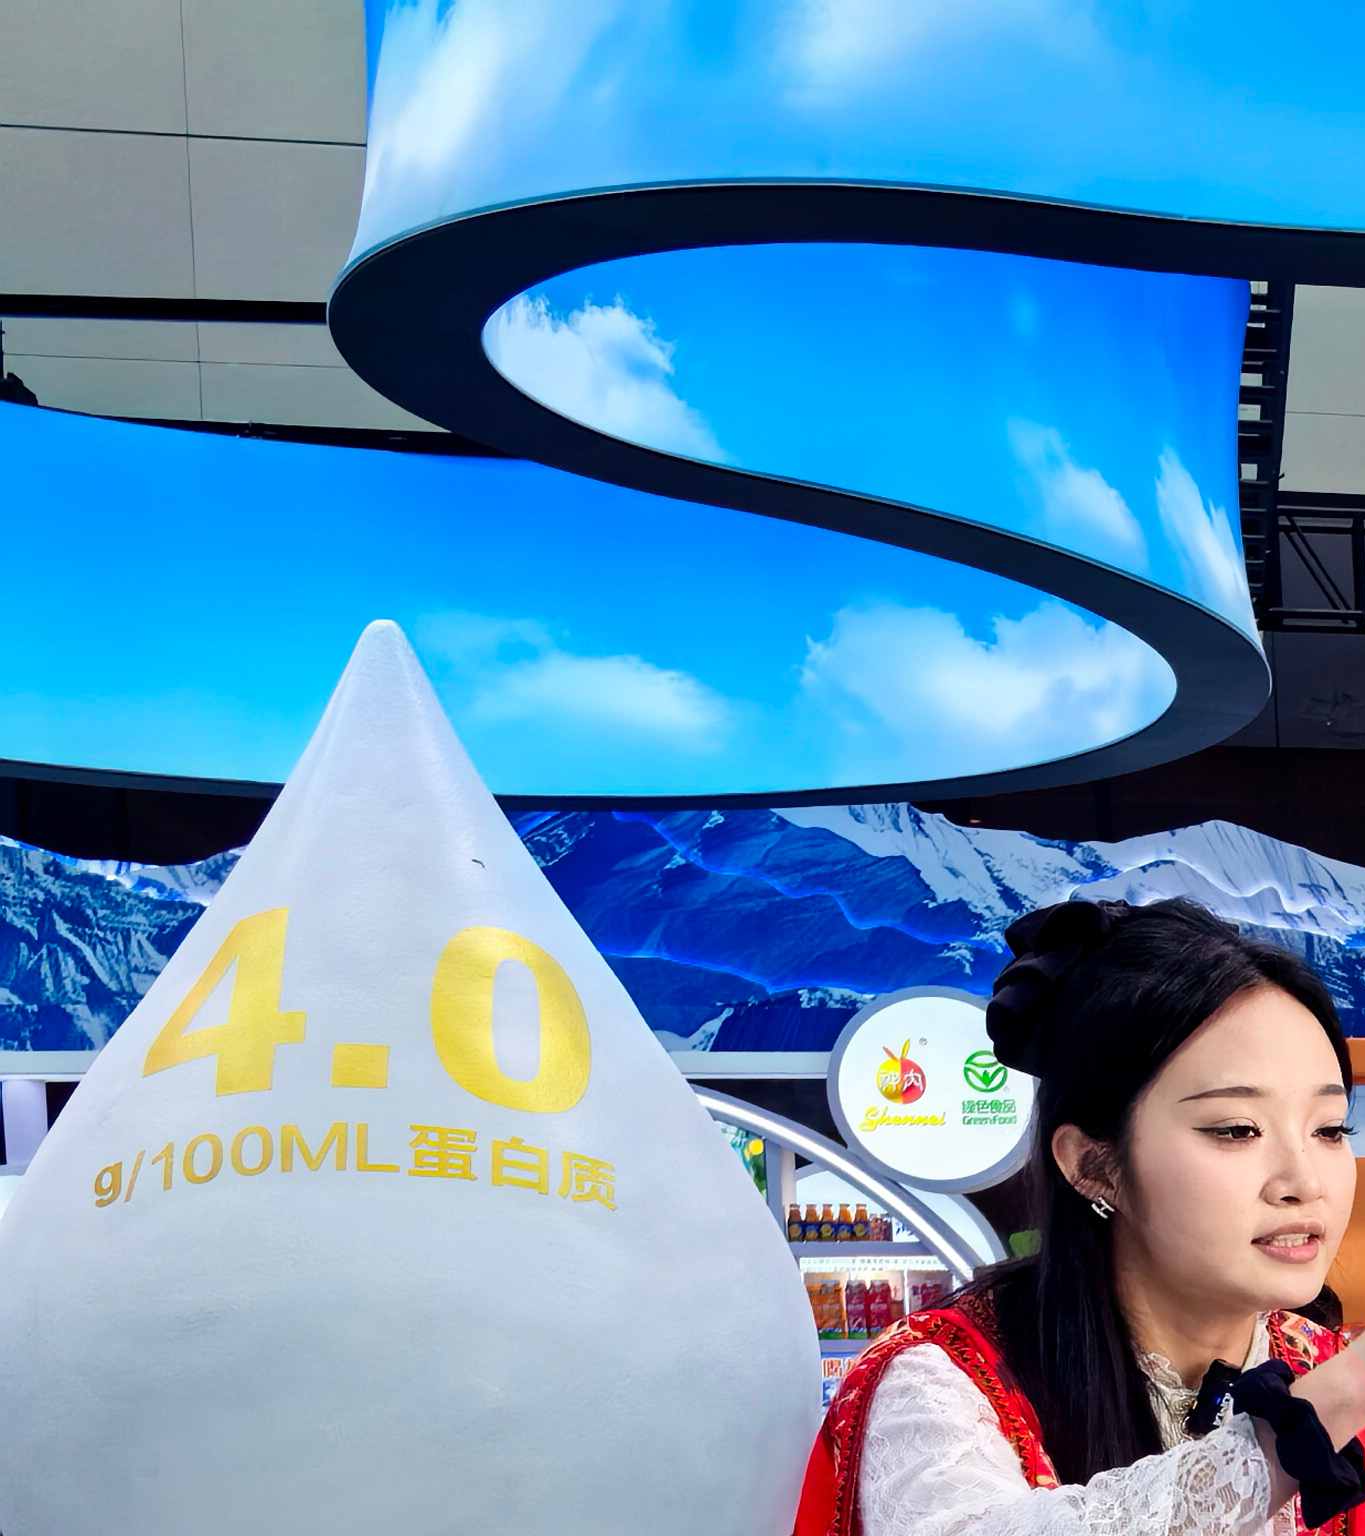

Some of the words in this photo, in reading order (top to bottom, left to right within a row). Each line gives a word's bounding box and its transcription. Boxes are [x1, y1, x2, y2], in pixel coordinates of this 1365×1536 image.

[142, 908, 592, 1114] 4.0
[93, 1122, 619, 1211] g/100ML蛋白质
